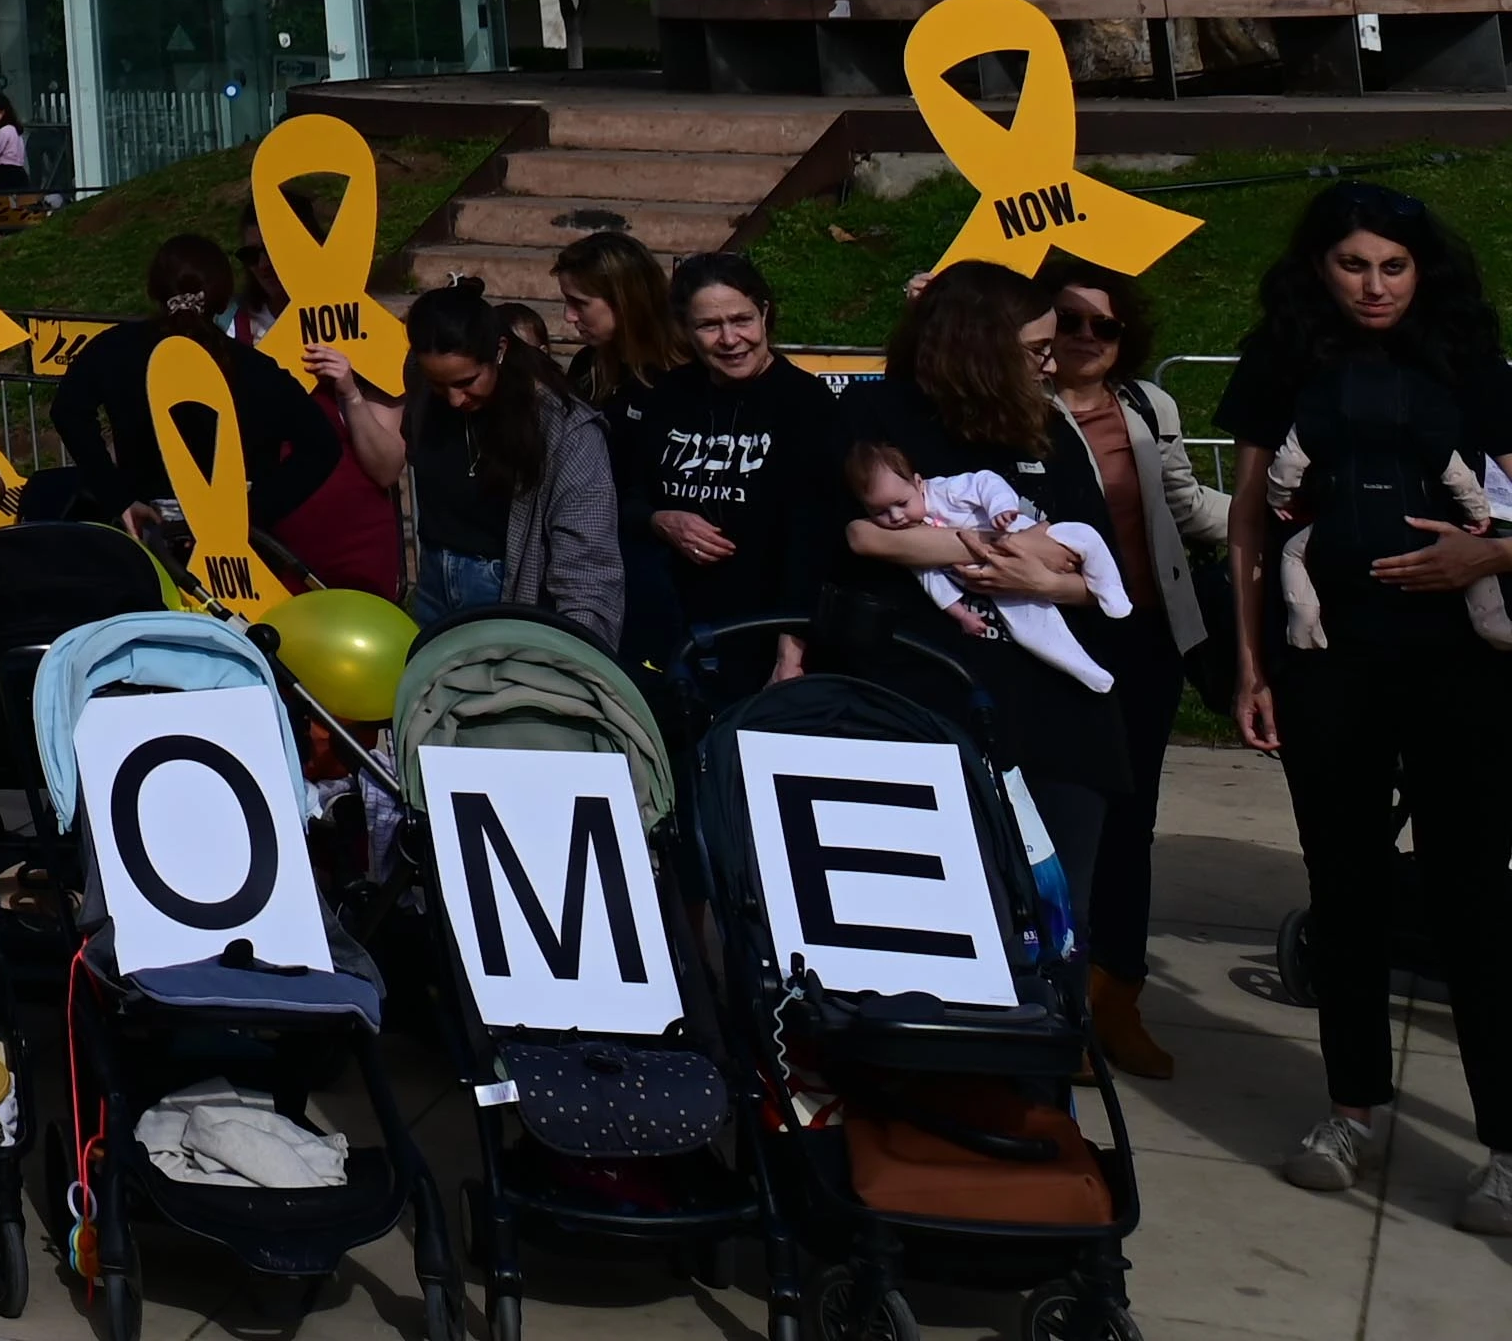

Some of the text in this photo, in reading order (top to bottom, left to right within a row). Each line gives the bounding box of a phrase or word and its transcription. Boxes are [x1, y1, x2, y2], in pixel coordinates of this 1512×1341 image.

[994, 183, 1087, 239] NOW.
[299, 302, 368, 345] NOW.
[662, 479, 747, 503] באוקטובר
[205, 556, 260, 601] NOW.
